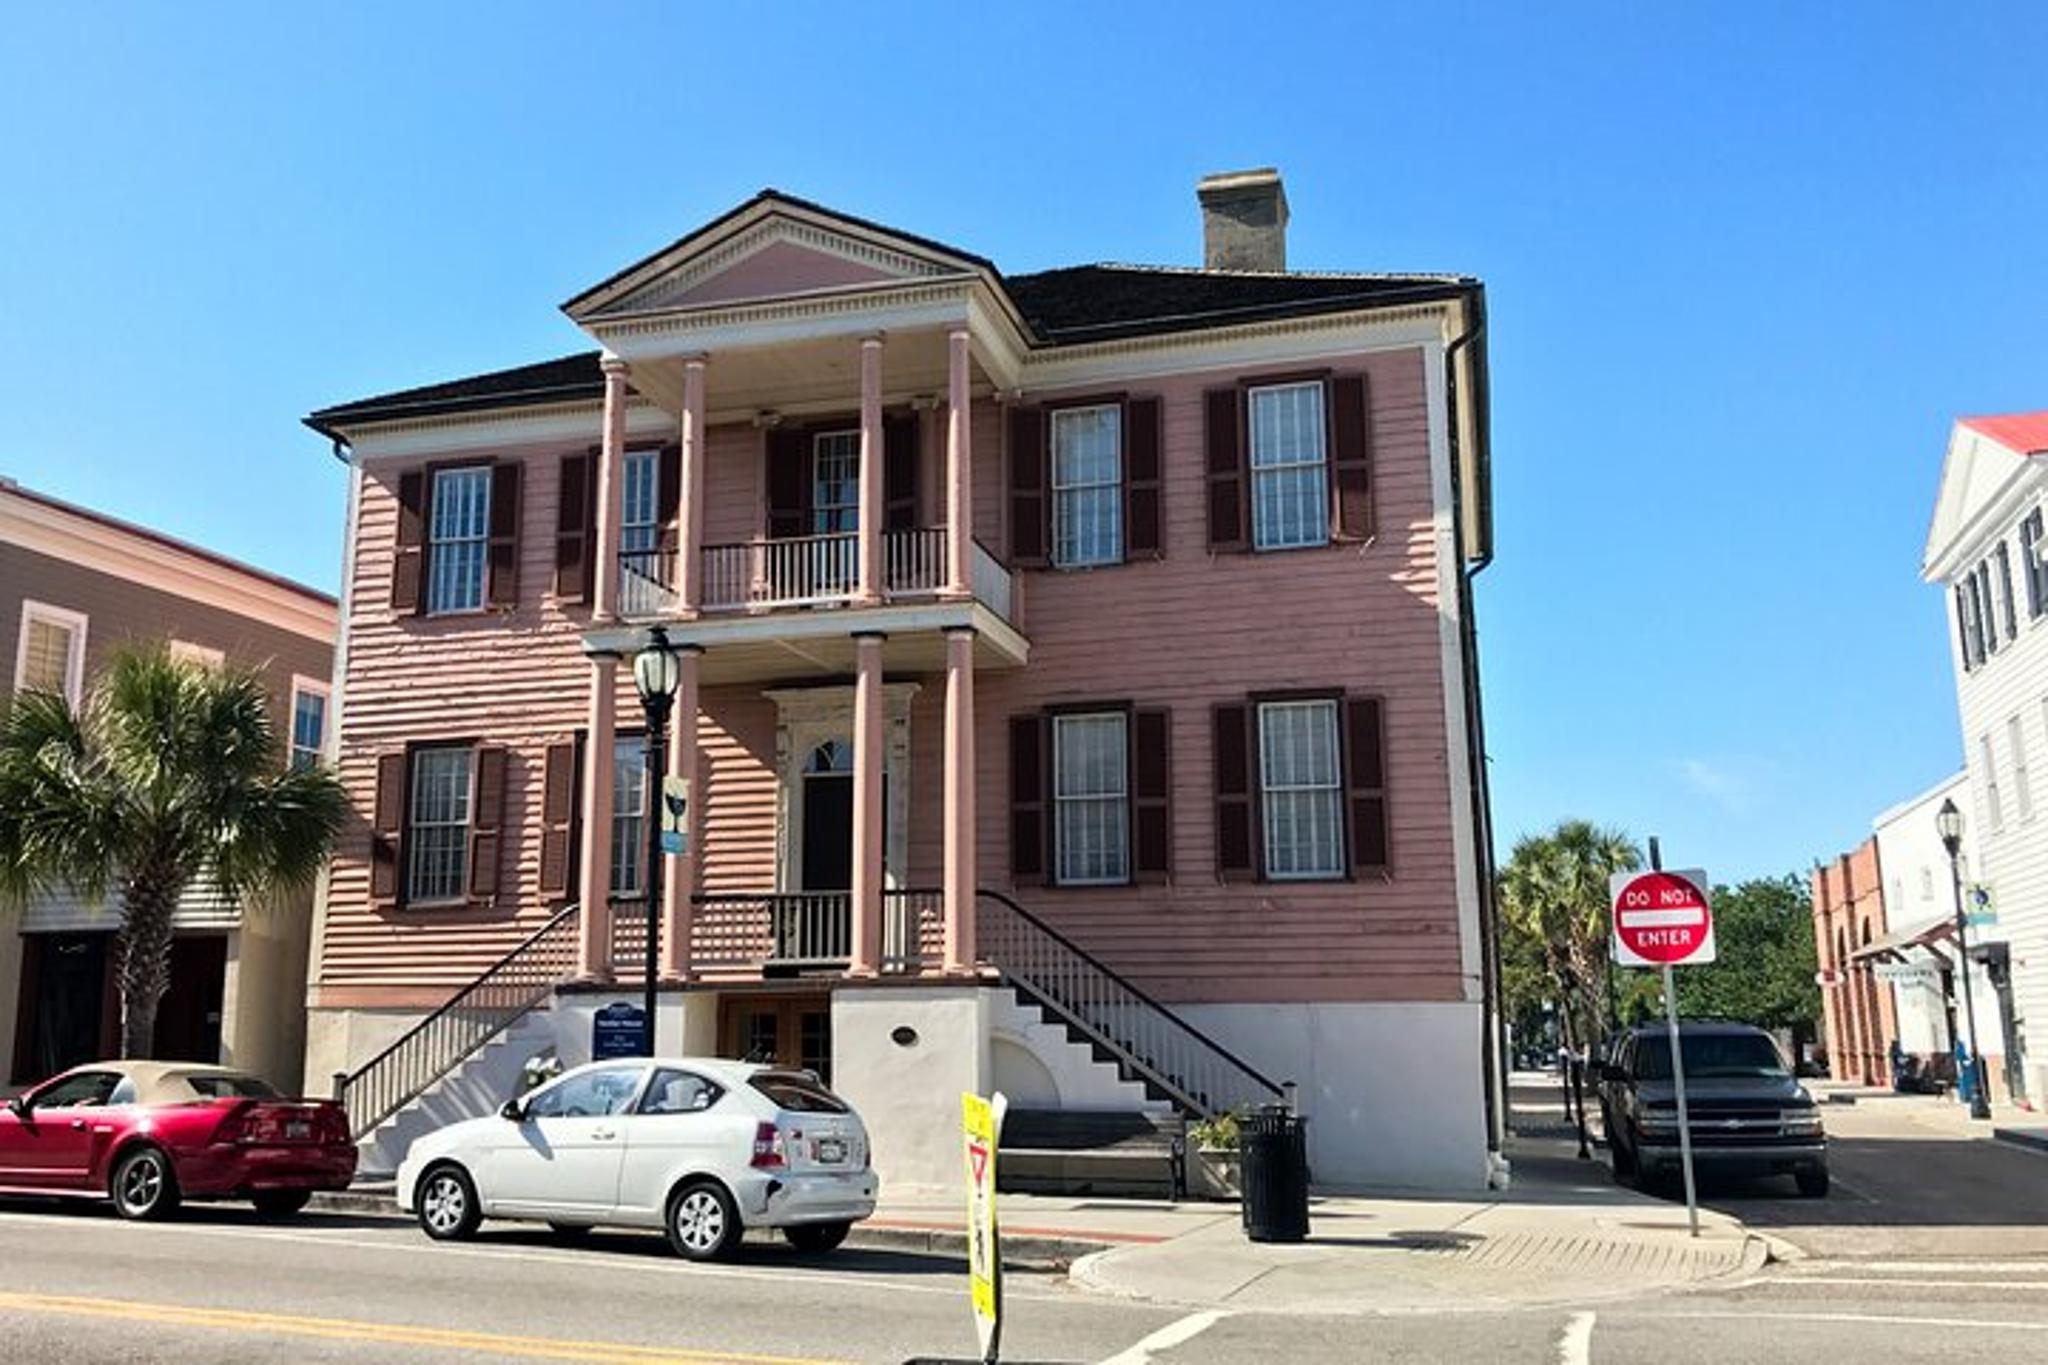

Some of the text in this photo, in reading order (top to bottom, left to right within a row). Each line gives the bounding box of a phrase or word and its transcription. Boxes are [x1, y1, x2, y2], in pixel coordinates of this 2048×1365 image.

[1626, 888, 1692, 907] DO NOT
[1637, 929, 1691, 947] ENTER
